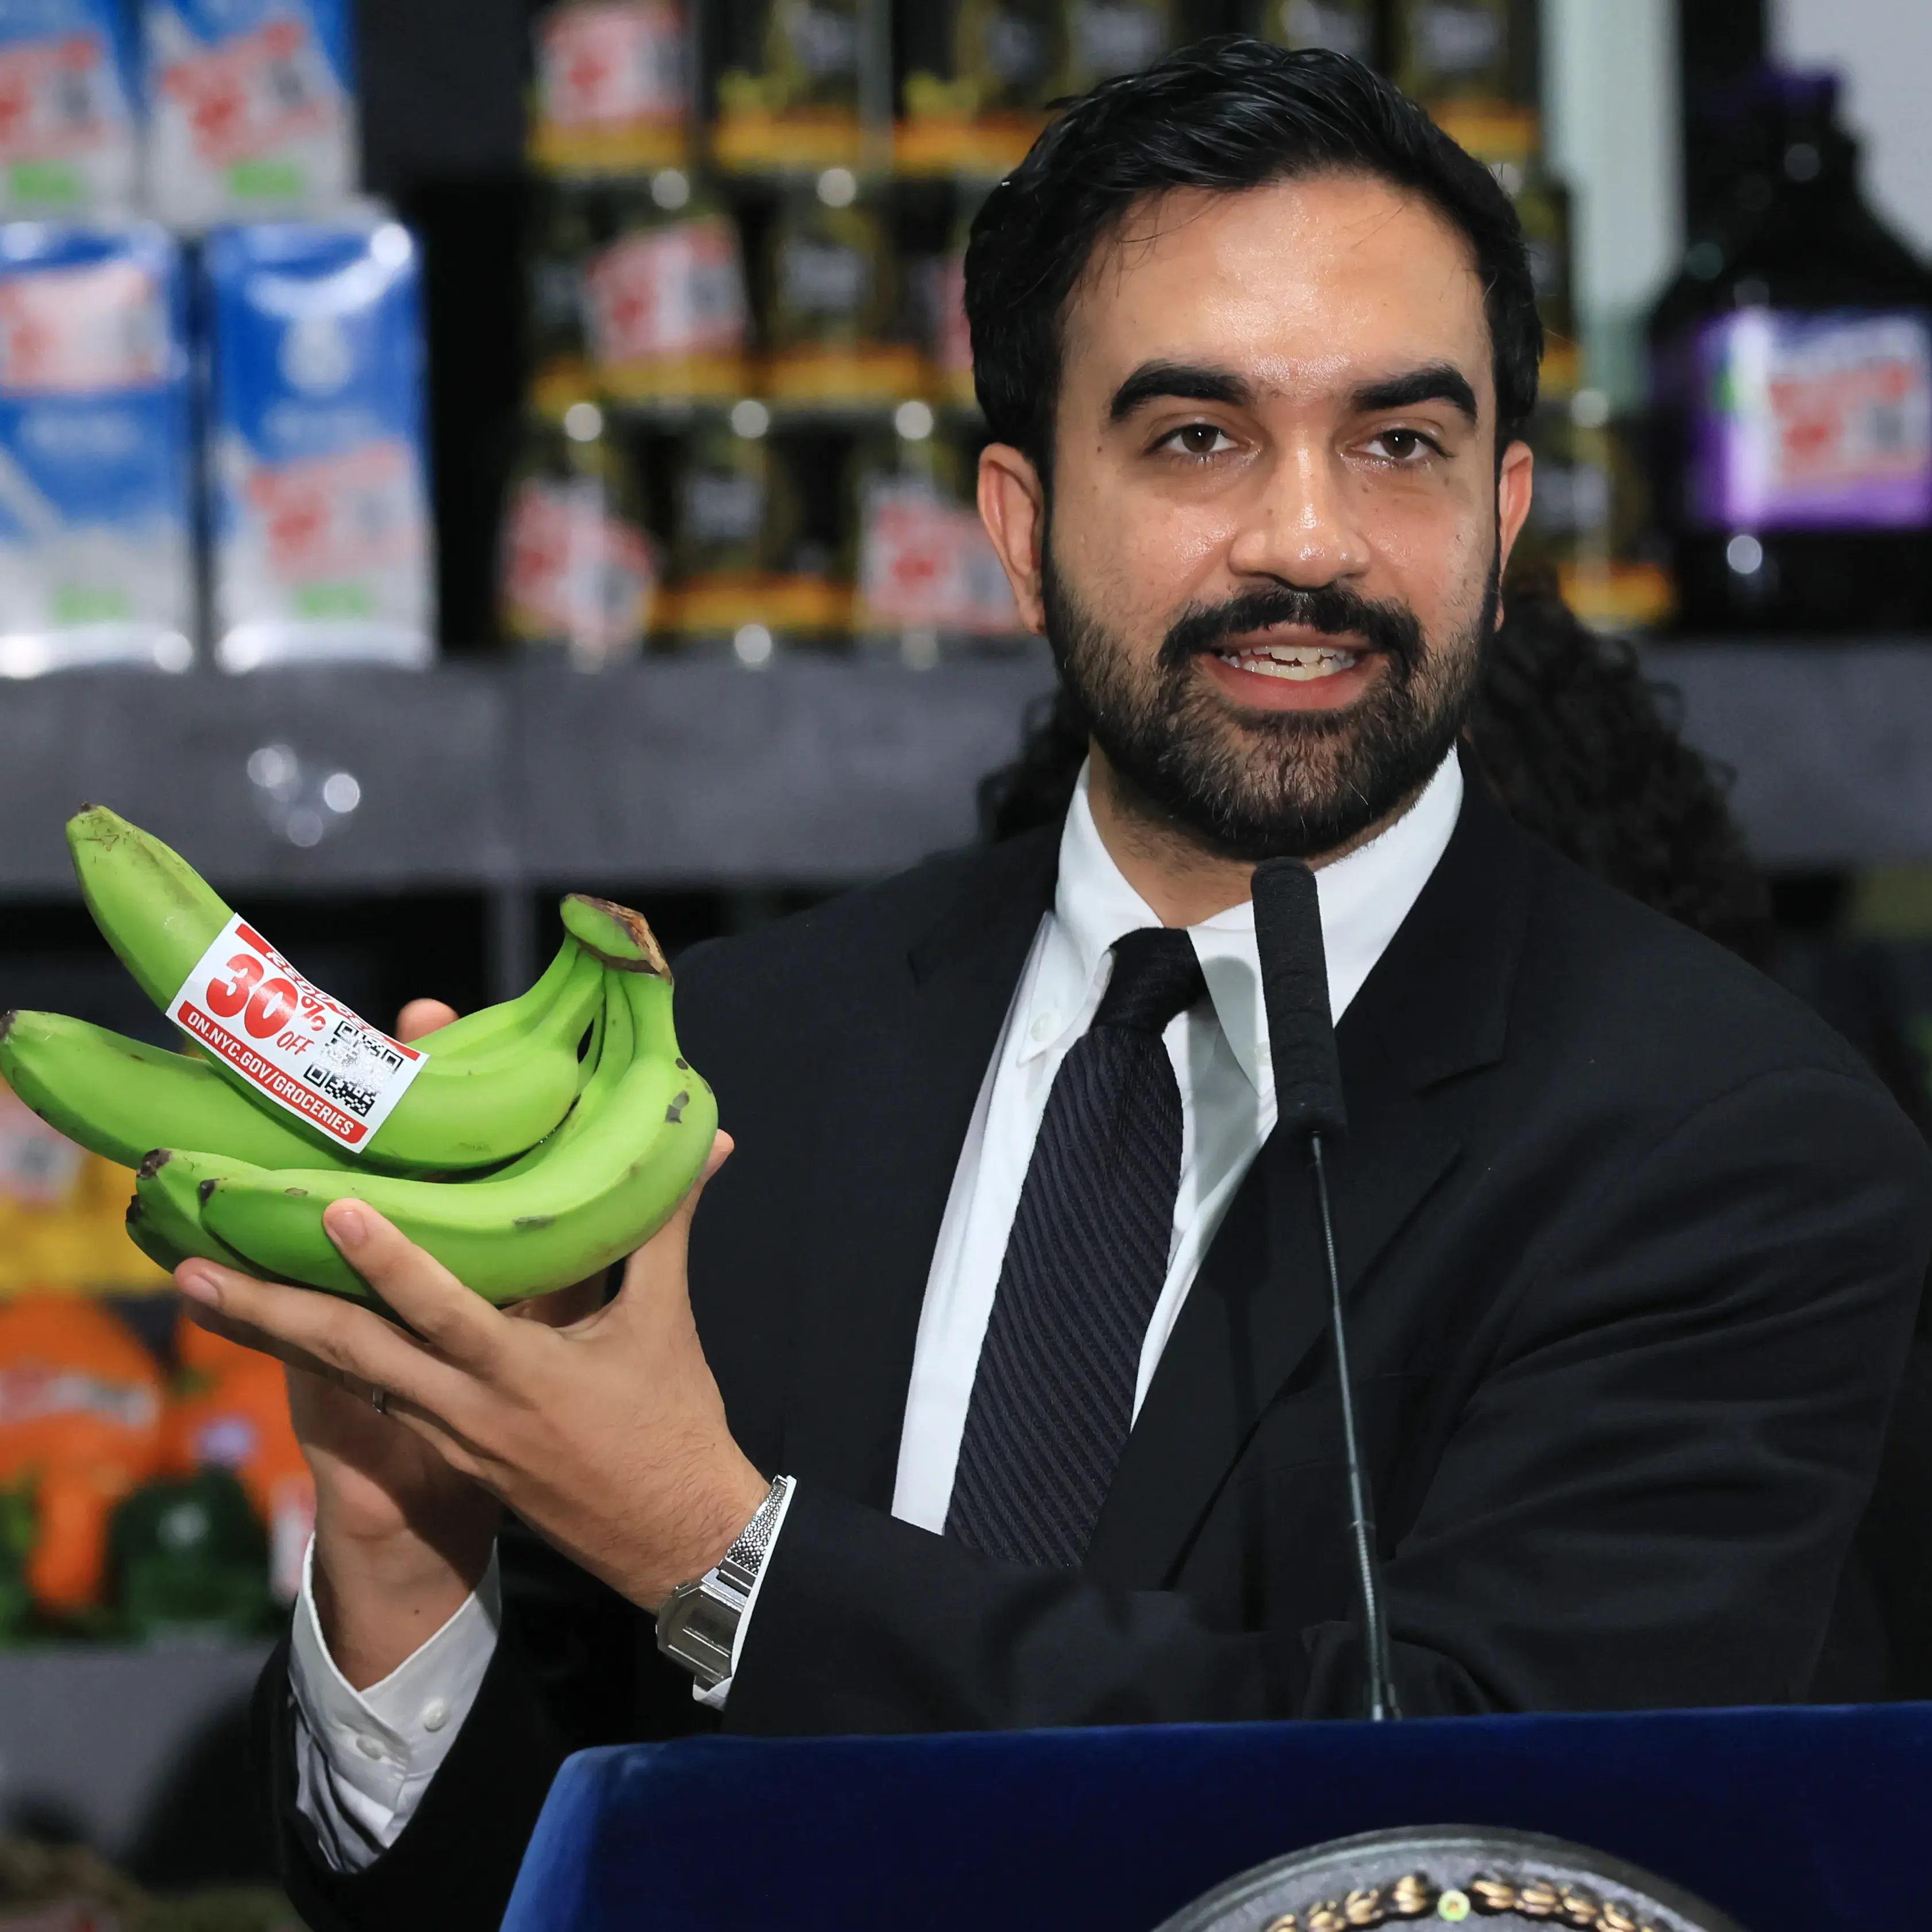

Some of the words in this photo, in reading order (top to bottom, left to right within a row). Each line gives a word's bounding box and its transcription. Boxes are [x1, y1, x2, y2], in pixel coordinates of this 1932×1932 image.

[206, 953, 326, 1039] 30%
[187, 1010, 355, 1136] ON.NYC.GOV/GROCERIES
[276, 1030, 315, 1056] OFF
